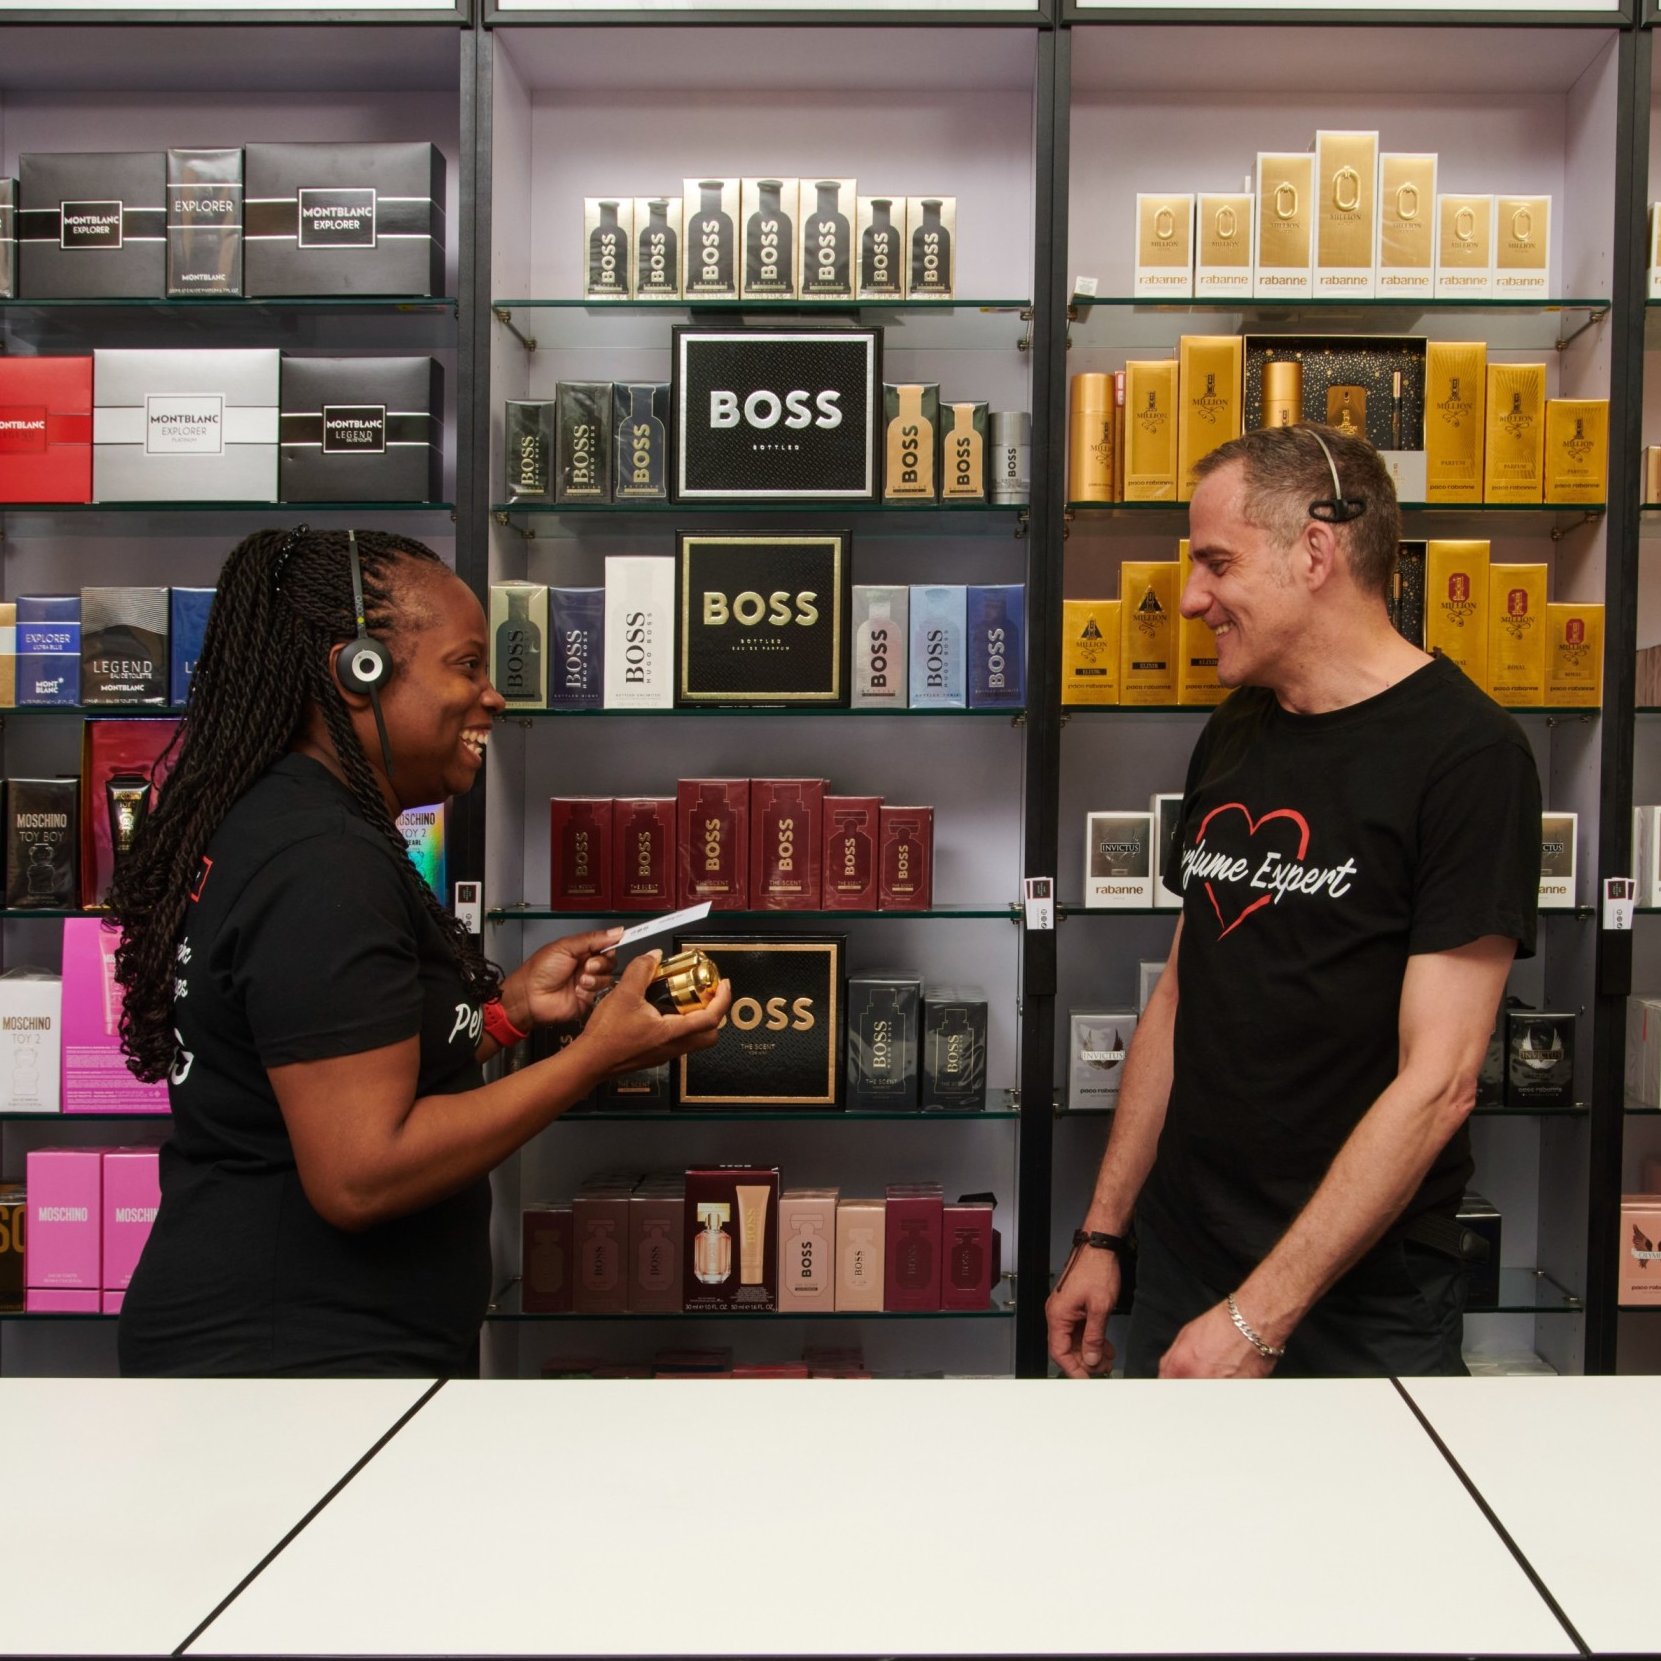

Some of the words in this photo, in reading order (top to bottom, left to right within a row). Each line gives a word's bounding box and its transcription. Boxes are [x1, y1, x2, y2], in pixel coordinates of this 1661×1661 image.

[174, 200, 233, 212] EXPLORER
[303, 207, 372, 218] MONTBLANC
[64, 216, 119, 225] MONTBLANC
[73, 226, 110, 234] EXPLORER
[314, 219, 360, 231] EXPLORER
[601, 233, 616, 283] BOSS
[650, 232, 665, 282] BOSS
[702, 220, 719, 280] BOSS
[761, 220, 778, 279] BOSS
[818, 221, 836, 280] BOSS
[873, 232, 888, 282] BOSS
[924, 232, 938, 282] BOSS
[1139, 275, 1187, 285] rabanne
[1200, 275, 1248, 284] rabanne
[1259, 275, 1307, 286] rabanne
[1320, 275, 1368, 285] rabanne
[1381, 275, 1429, 286] rabanne
[1439, 275, 1488, 286] rabanne
[1496, 276, 1545, 286] rabanne
[710, 389, 843, 429] BOSS
[1192, 398, 1229, 406] MILLION
[1437, 402, 1473, 410] MILLION
[0, 421, 45, 429] ONTBLANC
[150, 415, 219, 424] MONTBLANC
[161, 427, 207, 436] EXPLORER
[326, 420, 383, 429] MONTBLANC
[335, 431, 373, 439] LEGEND
[1562, 440, 1594, 448] MILLION
[520, 436, 535, 485] BOSS
[573, 424, 589, 484] BOSS
[632, 423, 650, 483] BOSS
[901, 424, 918, 483] BOSS
[956, 437, 971, 485] BOSS
[1007, 448, 1017, 478] BOSS
[703, 590, 819, 626] BOSS
[1441, 601, 1477, 609] MILLION
[25, 633, 71, 643] EXPLORER
[625, 611, 645, 684] BOSS
[1559, 643, 1590, 651] MILLION
[93, 660, 153, 673] LEGEND
[507, 629, 524, 688] BOSS
[566, 629, 582, 688] BOSS
[870, 628, 888, 688] BOSS
[926, 629, 943, 688] BOSS
[988, 627, 1006, 688] BOSS
[17, 813, 68, 828] MOSCHINO
[19, 831, 39, 842] TOY
[43, 831, 65, 842] BOY
[704, 818, 721, 871] BOSS
[778, 818, 794, 871] BOSS
[1102, 843, 1139, 852] INVICTUS
[575, 831, 588, 876] BOSS
[638, 831, 651, 877] BOSS
[844, 838, 856, 876] BOSS
[898, 844, 908, 879] BOSS
[1095, 884, 1144, 895] rabanne
[1250, 851, 1357, 905] Expert
[2, 1016, 51, 1030] MOSCHINO
[717, 997, 815, 1031] OSS
[873, 1020, 887, 1068] BOSS
[947, 1034, 960, 1073] BOSS
[1083, 1051, 1124, 1060] INVICTUS
[38, 1207, 88, 1222] MOSCHINO
[801, 1241, 812, 1277] BOSS
[854, 1250, 863, 1276] BOSS
